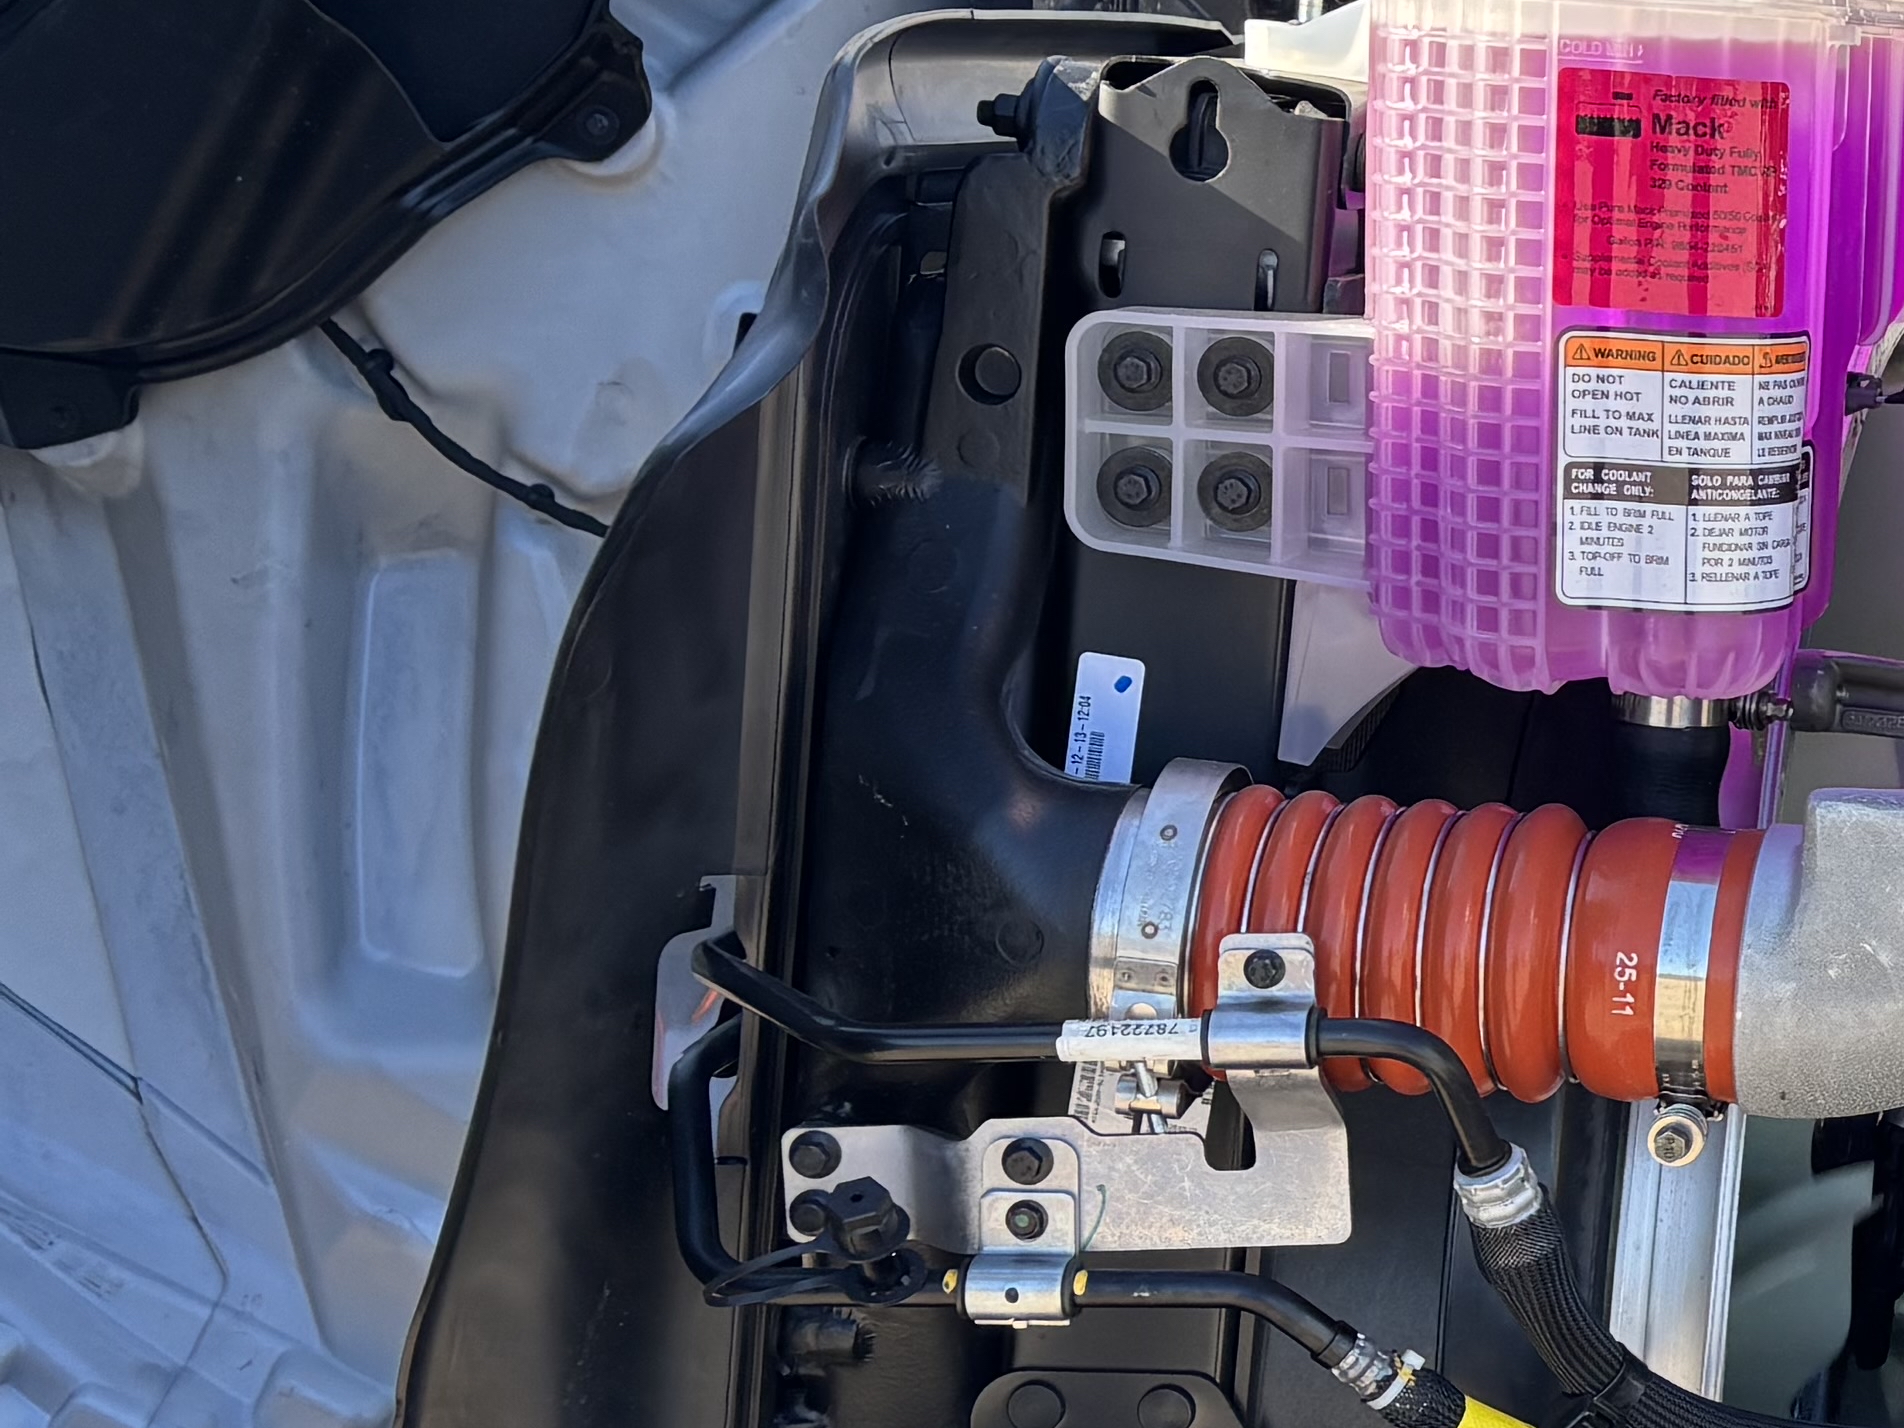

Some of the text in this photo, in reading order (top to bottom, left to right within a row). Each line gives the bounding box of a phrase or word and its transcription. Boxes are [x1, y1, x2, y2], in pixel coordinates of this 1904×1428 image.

[1559, 39, 1601, 56] COLD
[1652, 88, 1707, 108] Factory
[1710, 93, 1746, 108] filled
[1649, 140, 1760, 161] Heavy Duty Fully
[1648, 158, 1757, 177] Formulated TMC
[1648, 176, 1728, 194] 329 Coolant
[1592, 348, 1657, 362] WARNING
[1690, 353, 1750, 366] CUIDADO
[1571, 373, 1625, 385] DO NOT
[1669, 378, 1736, 391] CALIENTE
[1571, 389, 1642, 402] OPEN HOT
[1669, 394, 1735, 407] NO ABRIR
[1571, 409, 1654, 423] FILL TO MAX
[1668, 414, 1749, 426] LLENAR HASTA
[1571, 424, 1660, 439] LINE ON TANK
[1668, 430, 1746, 442] LINEA MAXIMA
[1668, 447, 1731, 458] EN TANQUE
[1571, 469, 1652, 483] FOR COOLANT
[1691, 475, 1754, 486] SOLO PARA
[1571, 482, 1654, 497] CHANGE ONLY:
[1579, 506, 1600, 517] FILL
[1605, 507, 1619, 518] TO
[1622, 508, 1646, 519] BRIM
[1651, 510, 1674, 521] FULL
[1702, 512, 1740, 522] LLENAR
[1744, 512, 1752, 522] A
[1579, 522, 1603, 532] IDLE
[1607, 523, 1644, 534] ENGINE
[1647, 524, 1654, 534] 2
[1702, 527, 1735, 538] DEJAR
[1738, 525, 1769, 537] MOTOR
[1579, 537, 1625, 547] MINUTES
[1579, 551, 1623, 563] TOP-OFF
[1627, 553, 1641, 563] TO
[1644, 555, 1669, 566] BRIM
[1701, 556, 1773, 567] POR 2 MINUTOS
[1579, 566, 1604, 577] FULL
[1701, 571, 1750, 582] RELLENAR
[1753, 571, 1760, 581] A
[1611, 951, 1638, 1016] 25-11
[1084, 1023, 1179, 1038] 78722197
